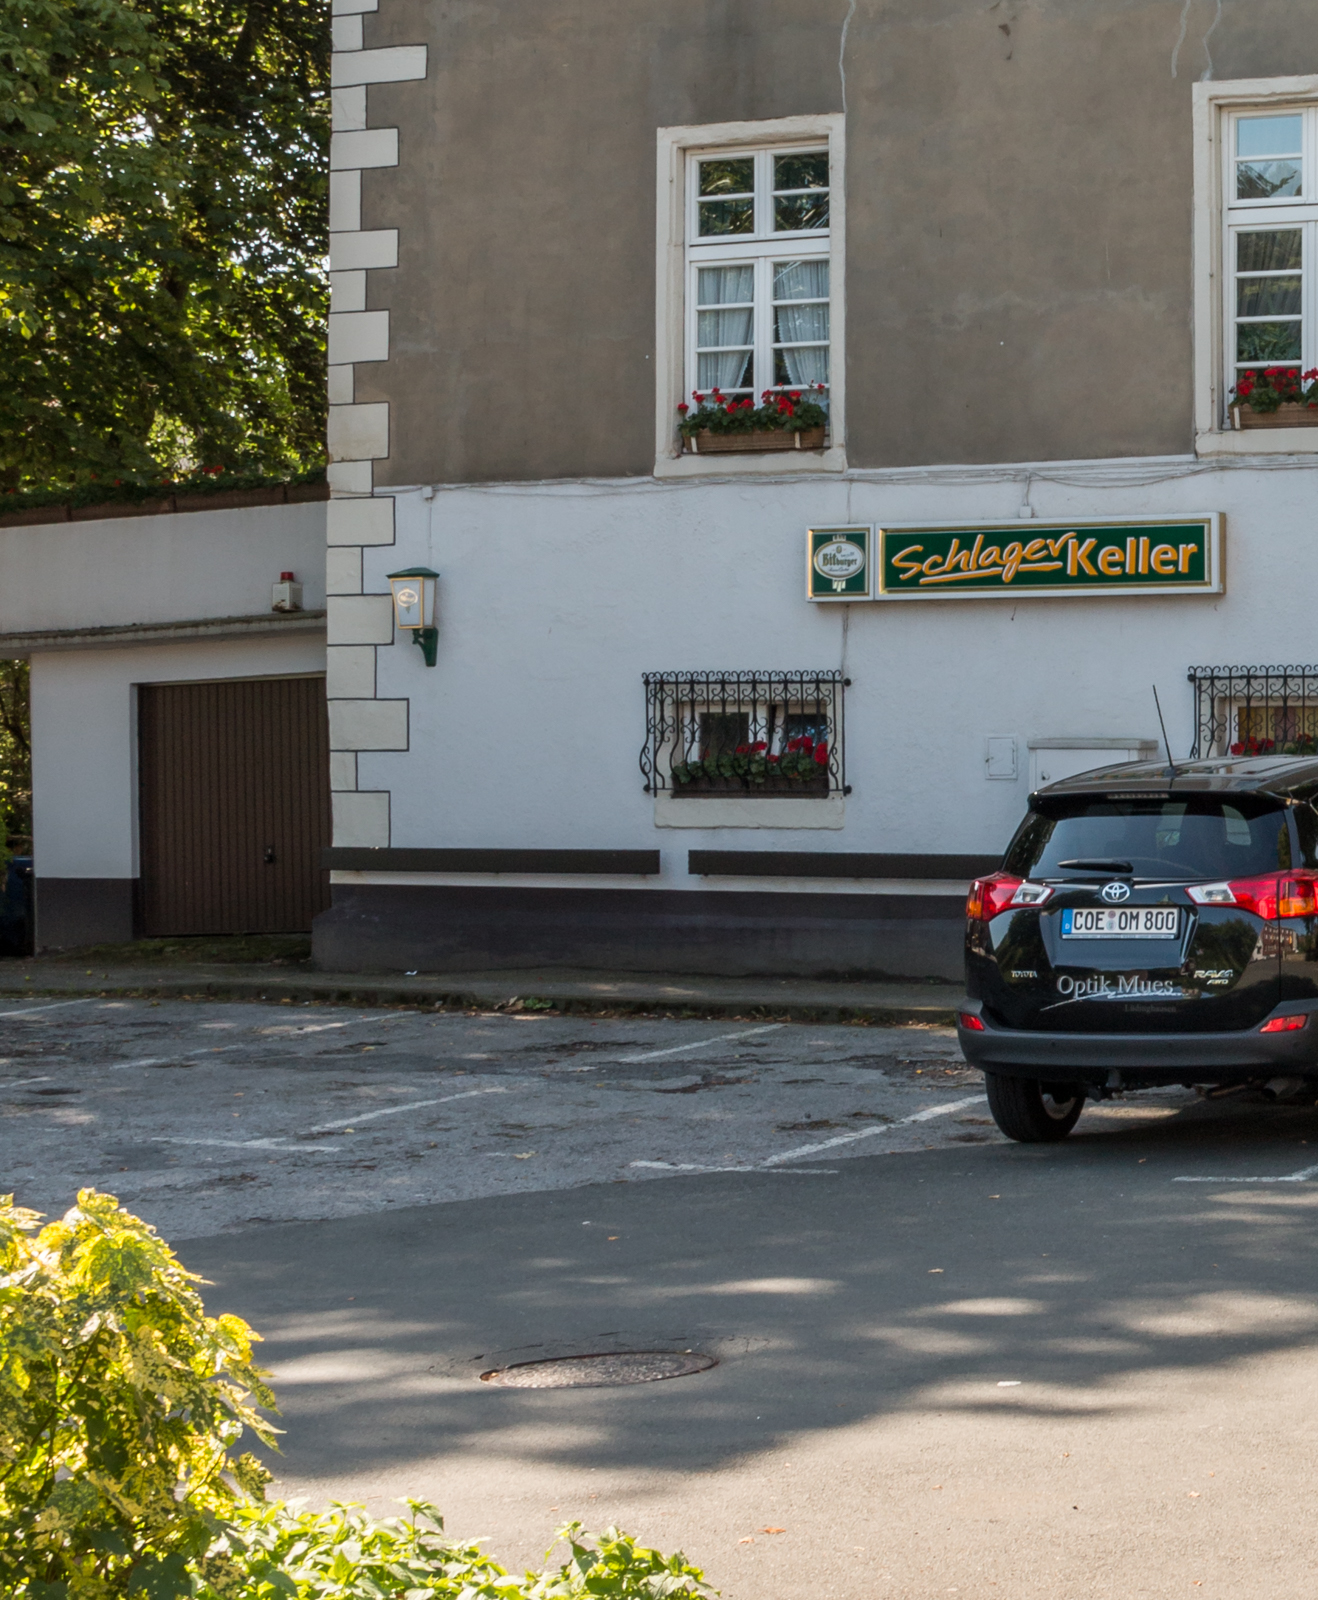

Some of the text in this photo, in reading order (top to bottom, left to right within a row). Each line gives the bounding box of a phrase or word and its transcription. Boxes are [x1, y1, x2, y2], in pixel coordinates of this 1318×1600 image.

[822, 552, 857, 567] Bitburger
[891, 532, 1198, 584] Schlager Keller
[1073, 911, 1105, 931] COE
[1118, 911, 1140, 931] OM
[1144, 911, 1175, 931] 800
[1011, 970, 1038, 978] TOYOTA
[1193, 969, 1234, 979] RAV4
[1057, 975, 1173, 1000] Optik Mues
